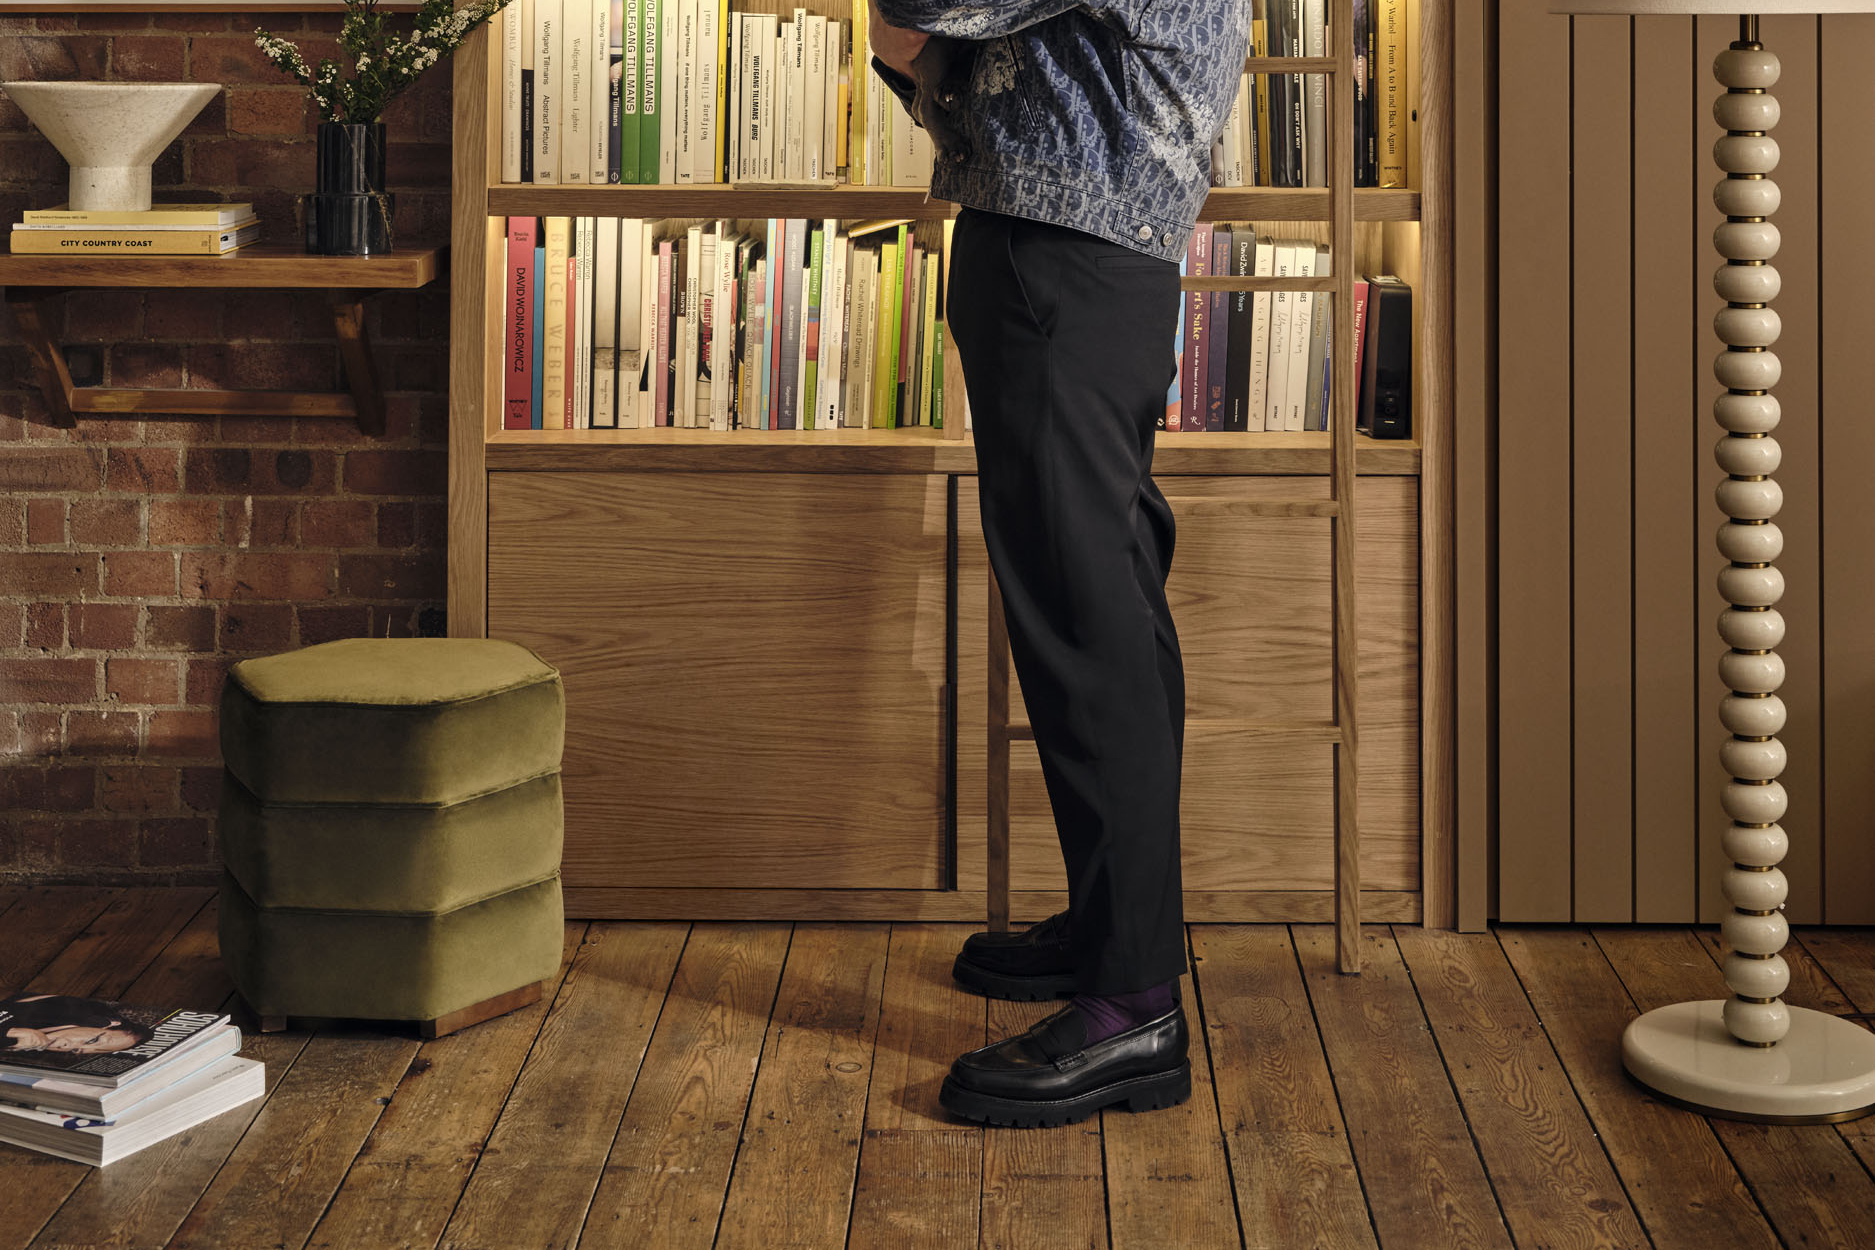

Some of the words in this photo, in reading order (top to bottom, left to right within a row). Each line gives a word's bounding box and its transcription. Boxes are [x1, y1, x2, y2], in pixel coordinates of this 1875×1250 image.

[542, 20, 551, 54] Wolfgang
[626, 56, 636, 112] TILLMANS
[645, 56, 655, 112] TILLMANS
[752, 55, 761, 89] WOLFGANG
[1388, 75, 1396, 84] to
[542, 94, 550, 125] Abstract
[751, 90, 760, 121] TILLMANS
[1388, 94, 1396, 108] and
[751, 124, 759, 141] BURG
[1388, 110, 1397, 129] Back
[542, 126, 550, 155] Pictures
[1386, 131, 1397, 155] Again
[549, 233, 563, 307] BRUCE
[723, 252, 731, 270] Rose
[515, 267, 526, 298] DAVID
[722, 271, 731, 293] Wylie
[857, 279, 866, 301] Rachel
[514, 297, 525, 373] WOJNAROWICZ
[703, 298, 712, 343] CHRISTOPHER
[856, 302, 865, 337] Whiteread
[547, 323, 563, 399] WEBER
[702, 344, 711, 362] WOOL
[854, 337, 863, 368] Drawings
